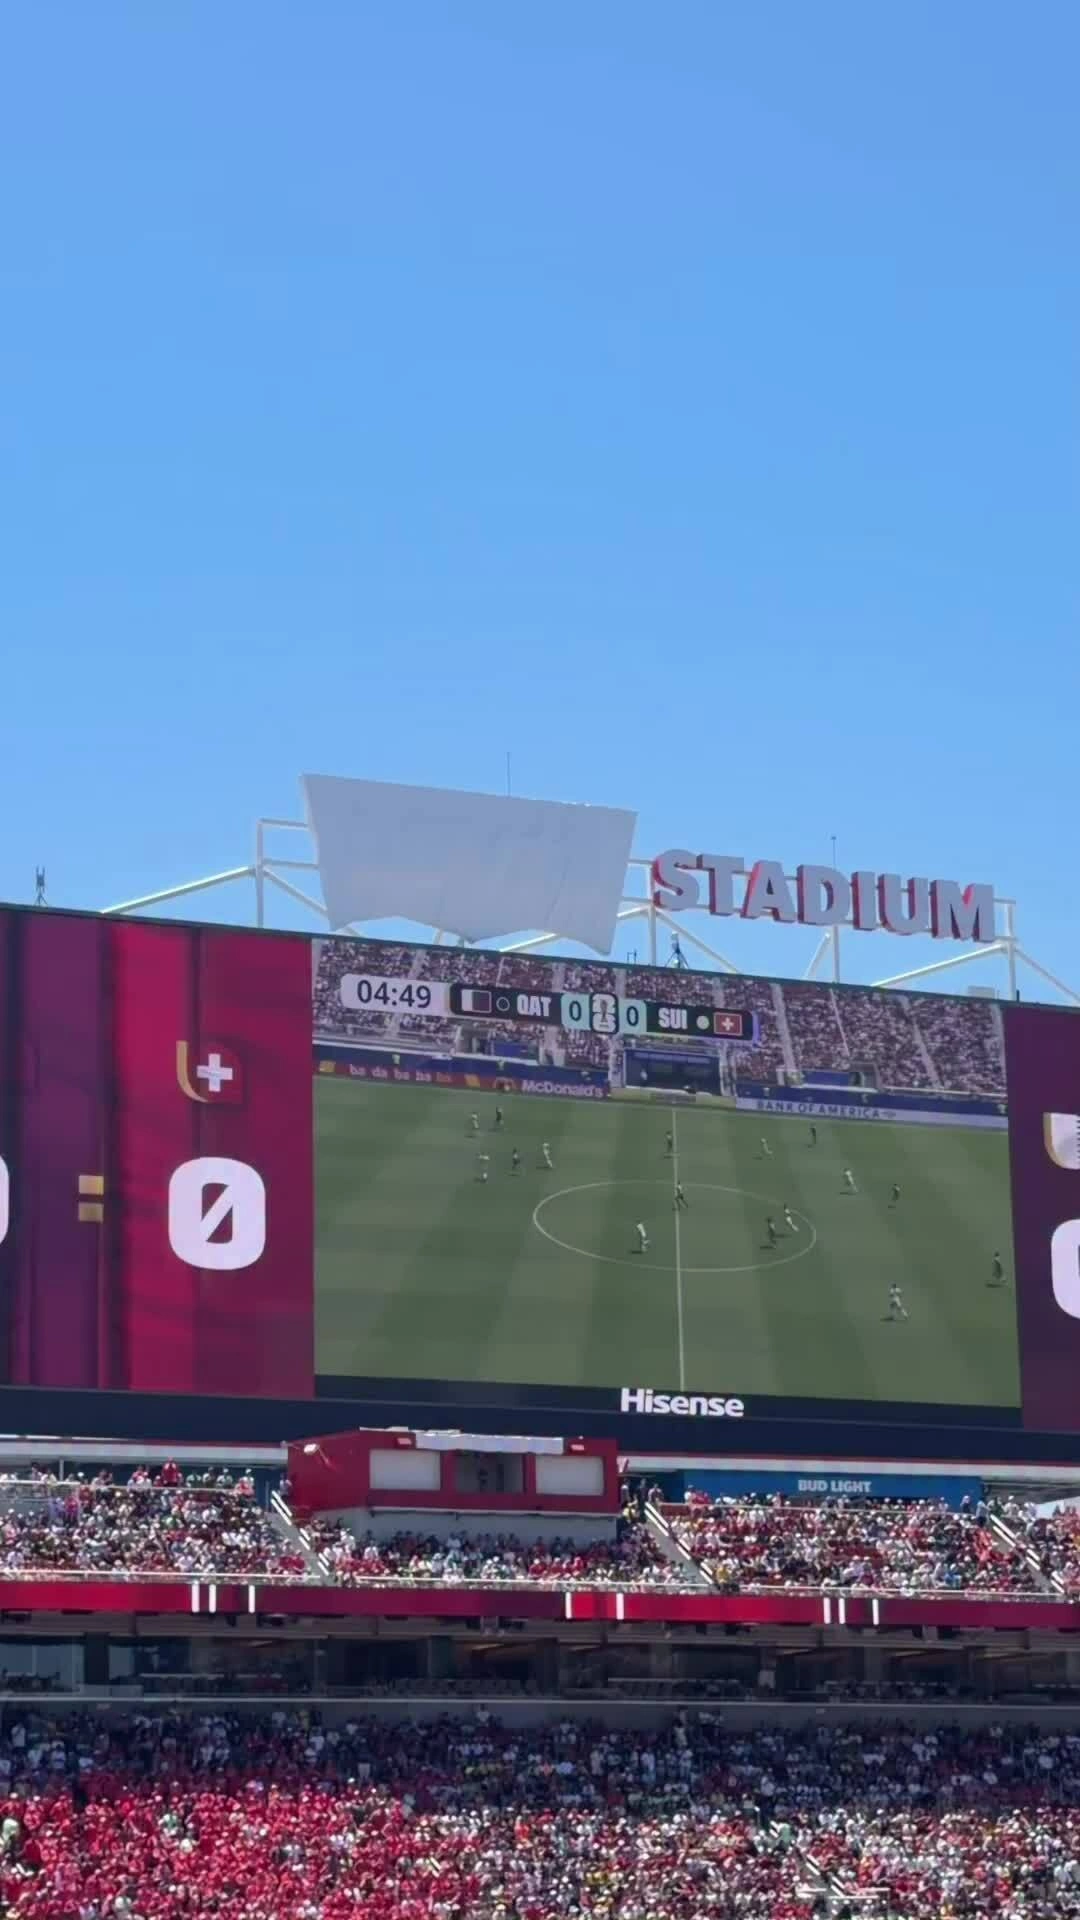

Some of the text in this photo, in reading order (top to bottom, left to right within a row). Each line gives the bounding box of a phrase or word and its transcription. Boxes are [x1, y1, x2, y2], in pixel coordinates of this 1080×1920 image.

[653, 848, 995, 943] STADIUM
[357, 979, 431, 1009] 04:49
[516, 994, 551, 1017] QAT
[569, 1000, 582, 1021] 0
[626, 1006, 639, 1026] 0
[658, 1007, 688, 1030] SUI
[521, 1079, 603, 1097] McDonald's
[757, 1101, 880, 1119] BANK OF AMERICA
[621, 1387, 745, 1417] Hisense
[798, 1480, 872, 1493] BUD LIGHT
